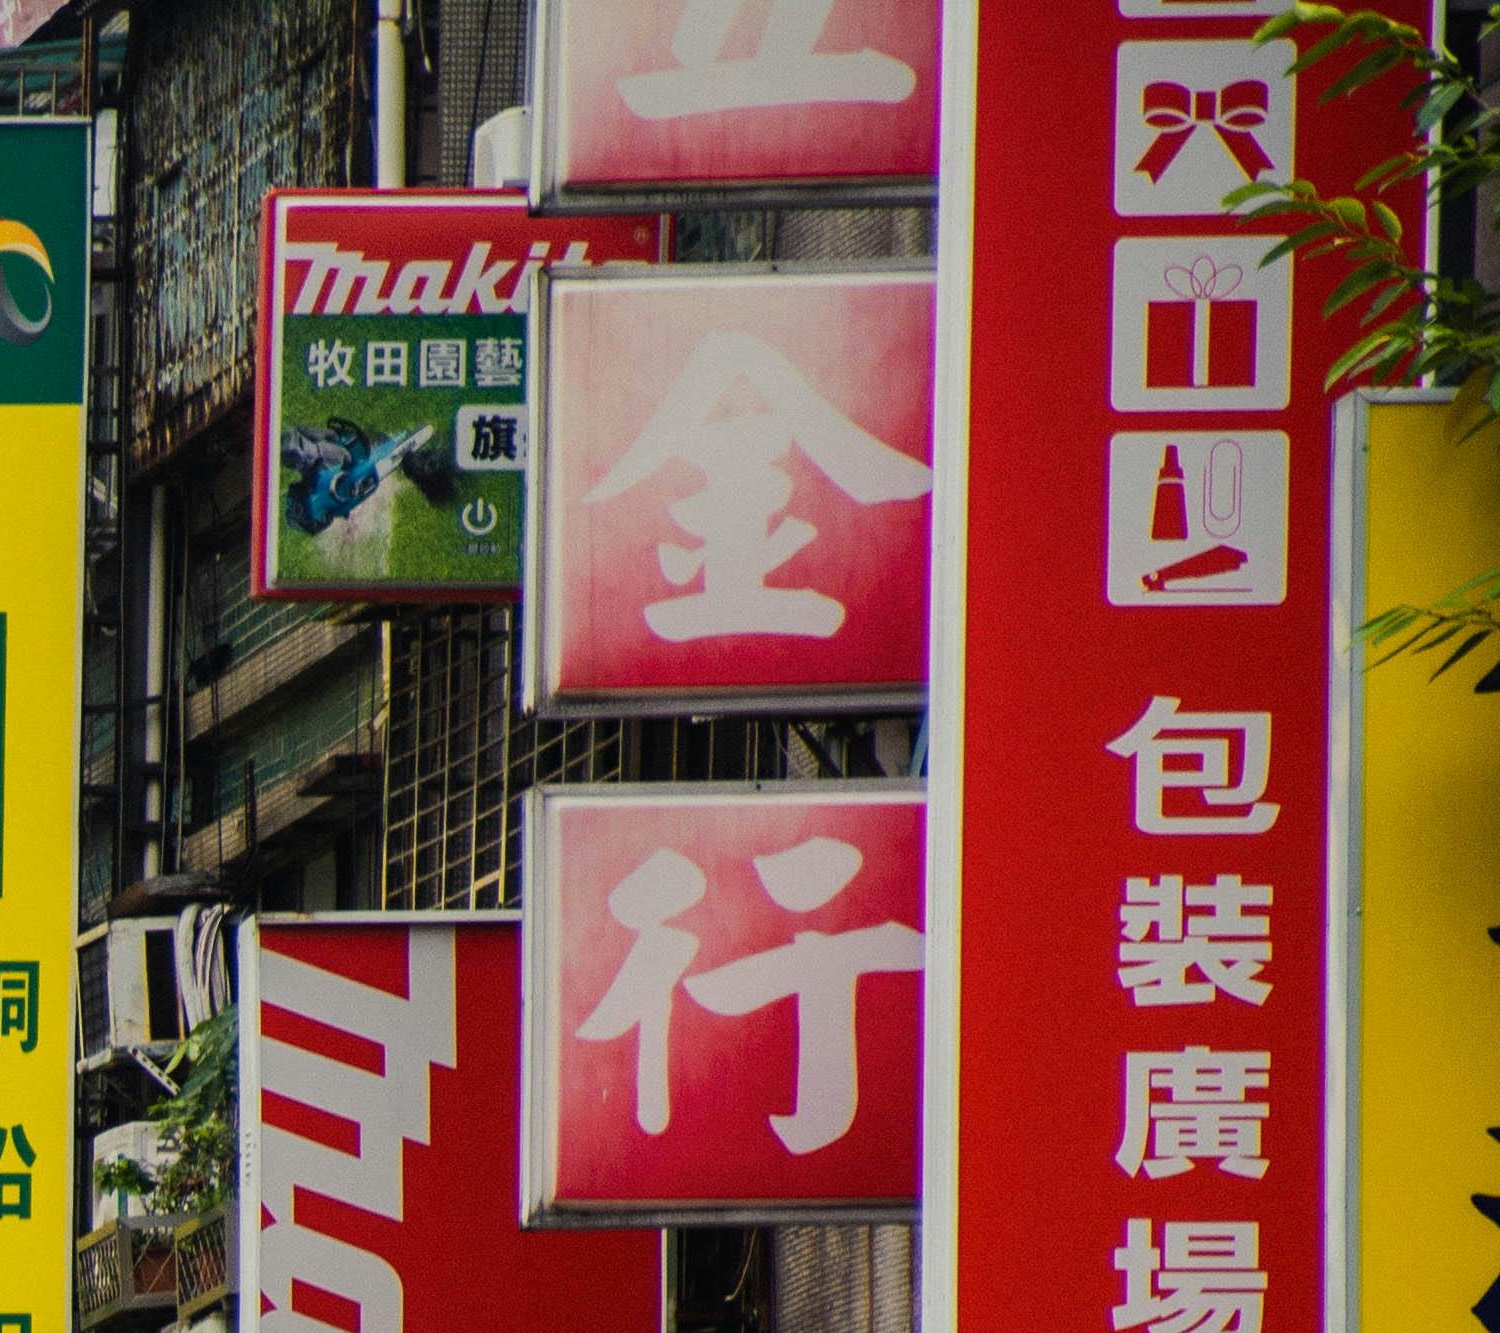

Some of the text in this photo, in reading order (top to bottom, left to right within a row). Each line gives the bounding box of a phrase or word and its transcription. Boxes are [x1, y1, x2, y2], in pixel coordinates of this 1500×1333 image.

[307, 337, 525, 389] 牧田園藝
[471, 414, 527, 461] 旗
